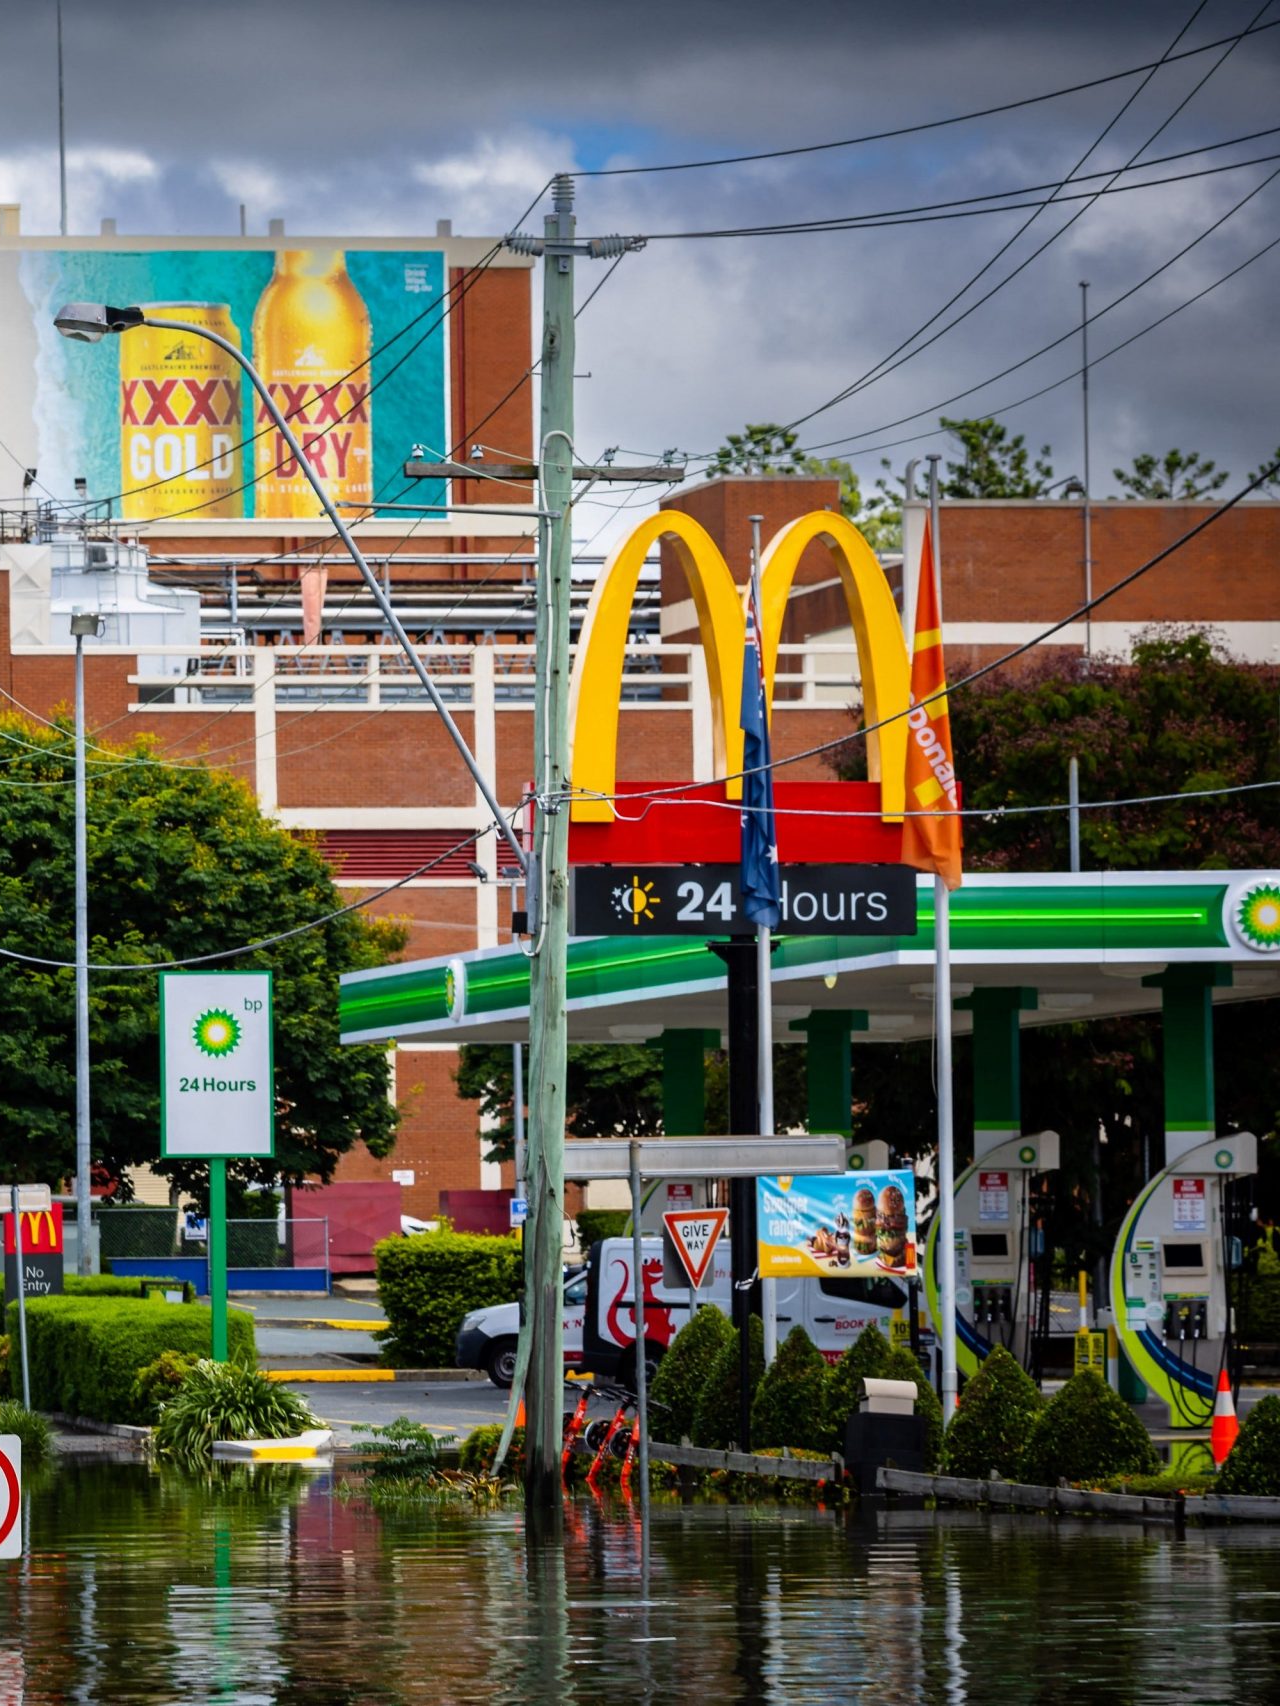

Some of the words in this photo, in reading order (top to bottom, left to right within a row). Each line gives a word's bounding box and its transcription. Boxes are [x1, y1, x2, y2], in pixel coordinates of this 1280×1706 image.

[121, 379, 241, 426] XXXX
[130, 433, 234, 481] GOLD
[275, 431, 353, 479] DRY
[676, 880, 737, 921] 24
[244, 998, 263, 1012] bp
[179, 1077, 200, 1092] 24
[203, 1077, 256, 1092] Hours
[681, 1223, 710, 1238] GIVE
[686, 1240, 706, 1251] WAY
[25, 1265, 45, 1279] No
[22, 1278, 51, 1295] Entry
[835, 1319, 865, 1331] BOOK
